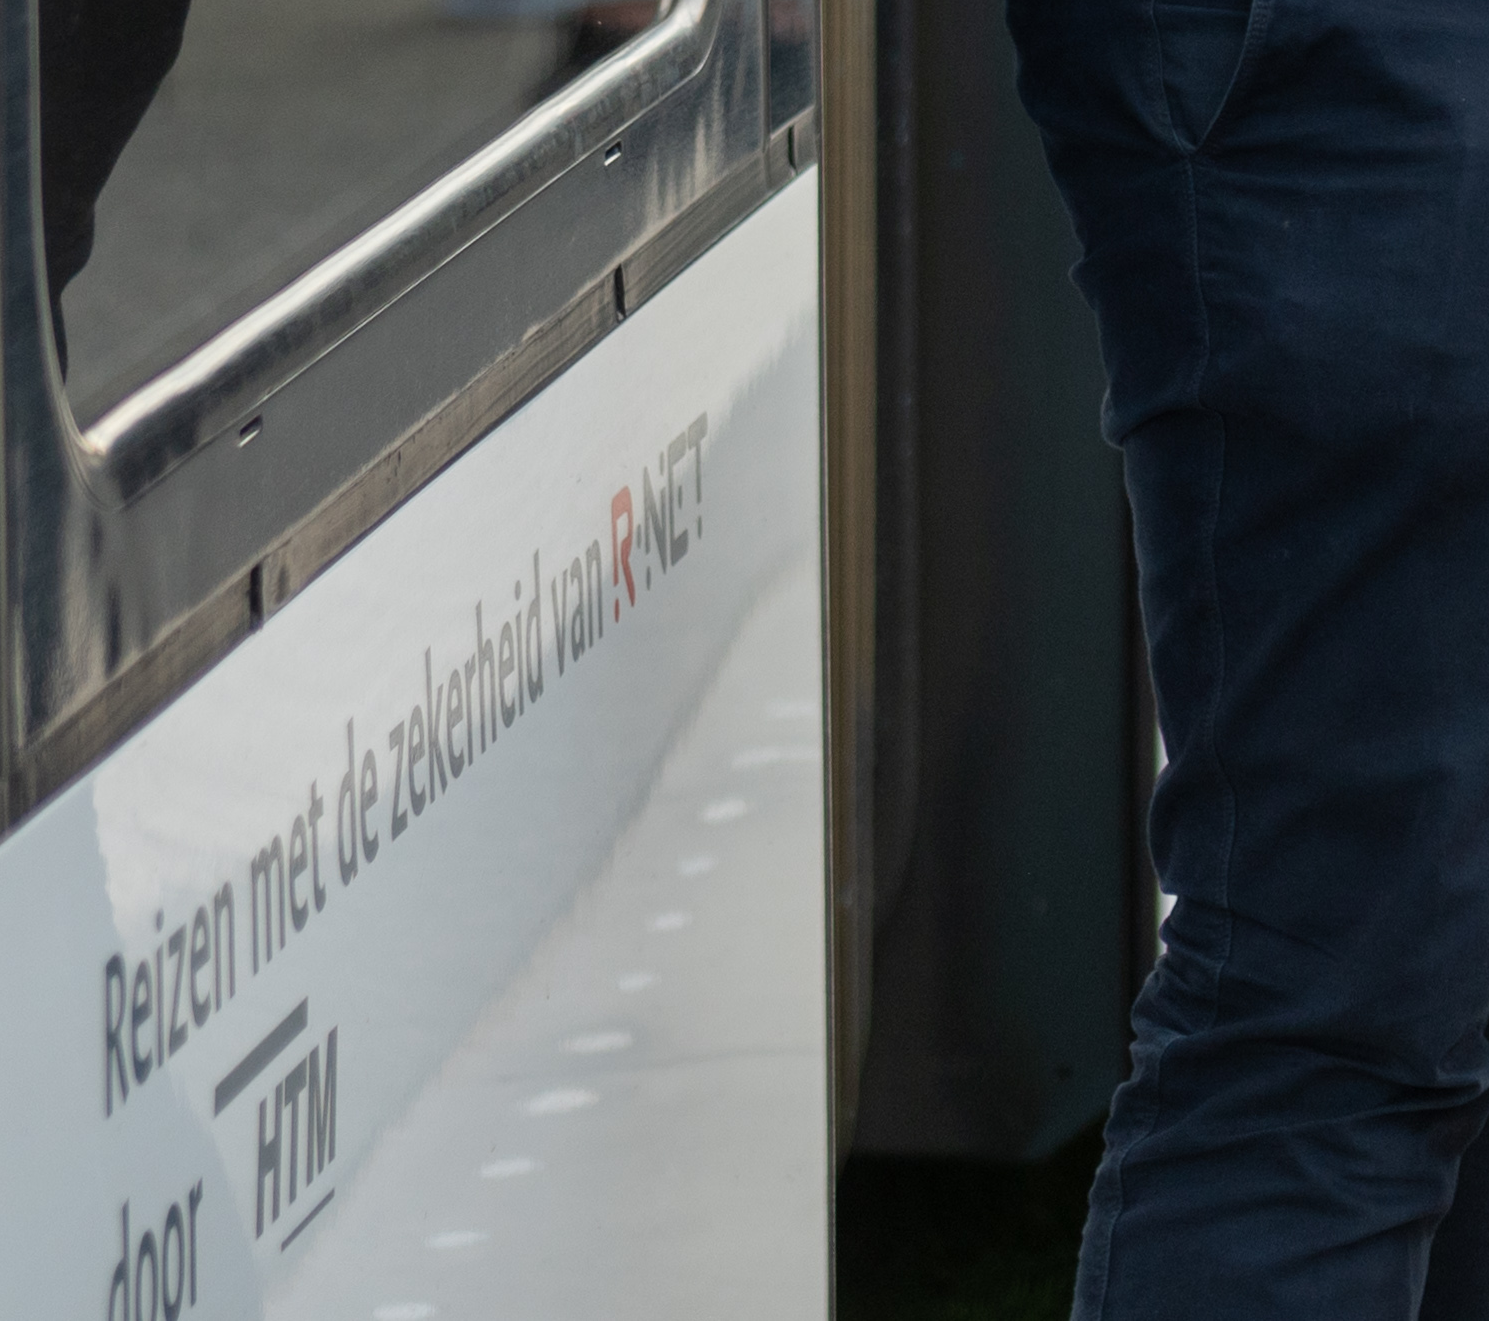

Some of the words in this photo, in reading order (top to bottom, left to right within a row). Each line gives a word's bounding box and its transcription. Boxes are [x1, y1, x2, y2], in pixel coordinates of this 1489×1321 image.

[104, 879, 236, 1119] Reizen
[251, 778, 327, 977] met
[338, 716, 380, 887] de
[389, 548, 544, 843] zekerheid
[551, 539, 603, 678] van
[108, 1176, 204, 1321] door
[255, 1024, 338, 1241] HTM
